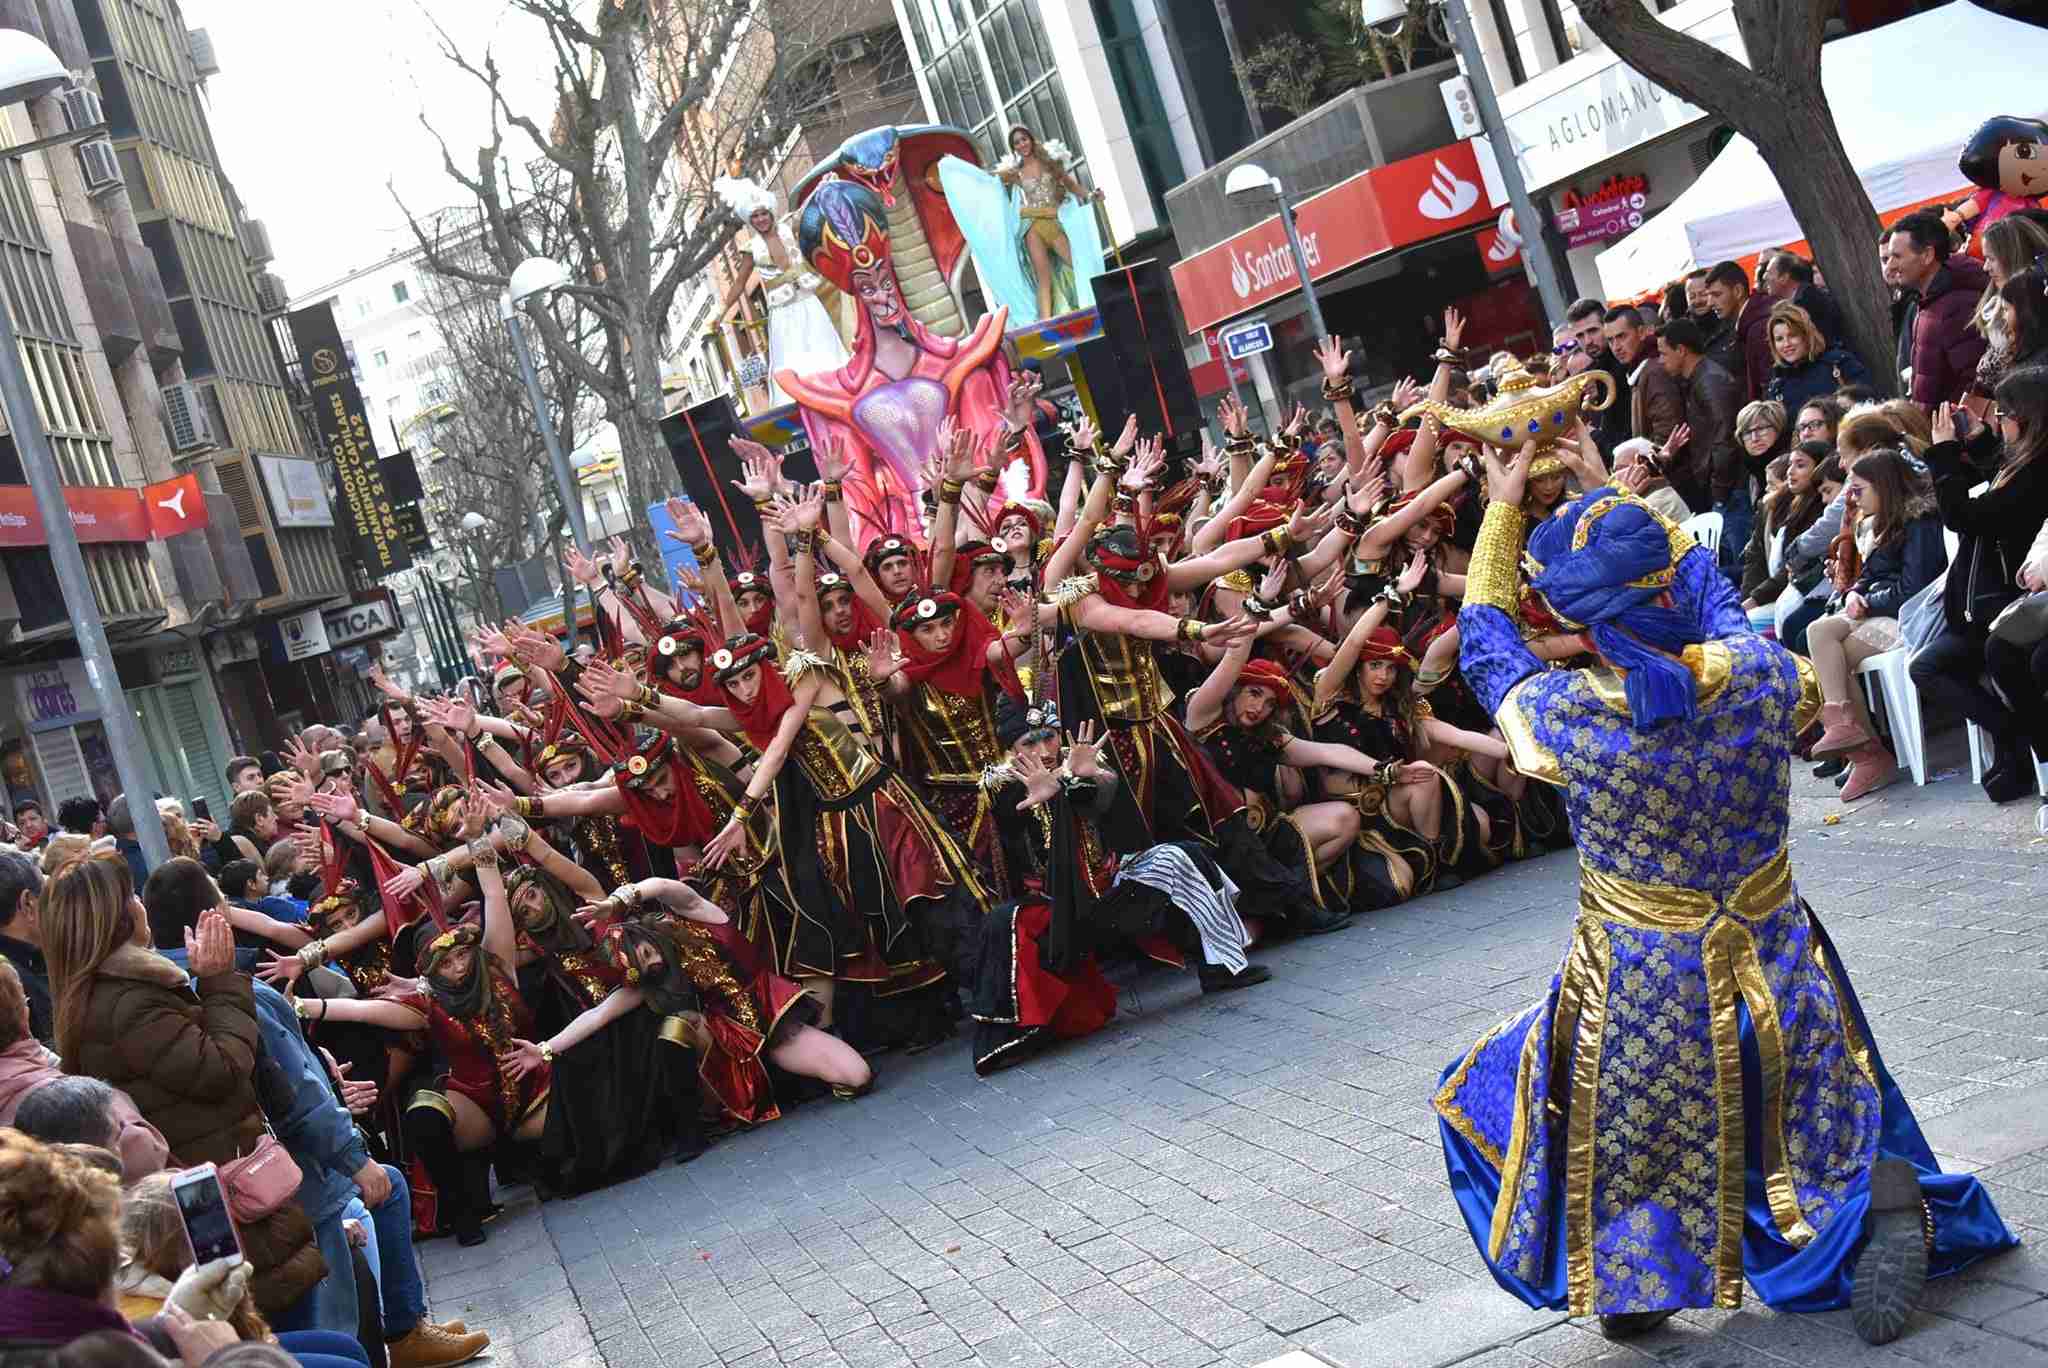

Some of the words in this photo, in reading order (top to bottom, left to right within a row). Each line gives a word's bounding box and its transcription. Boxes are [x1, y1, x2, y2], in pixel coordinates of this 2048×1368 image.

[329, 393, 360, 465] CAPILARES
[350, 412, 370, 451] 142
[364, 459, 385, 496] 211
[353, 467, 394, 569] TRATAMIENTOS
[379, 501, 399, 541] 926
[327, 609, 383, 638] TICA
